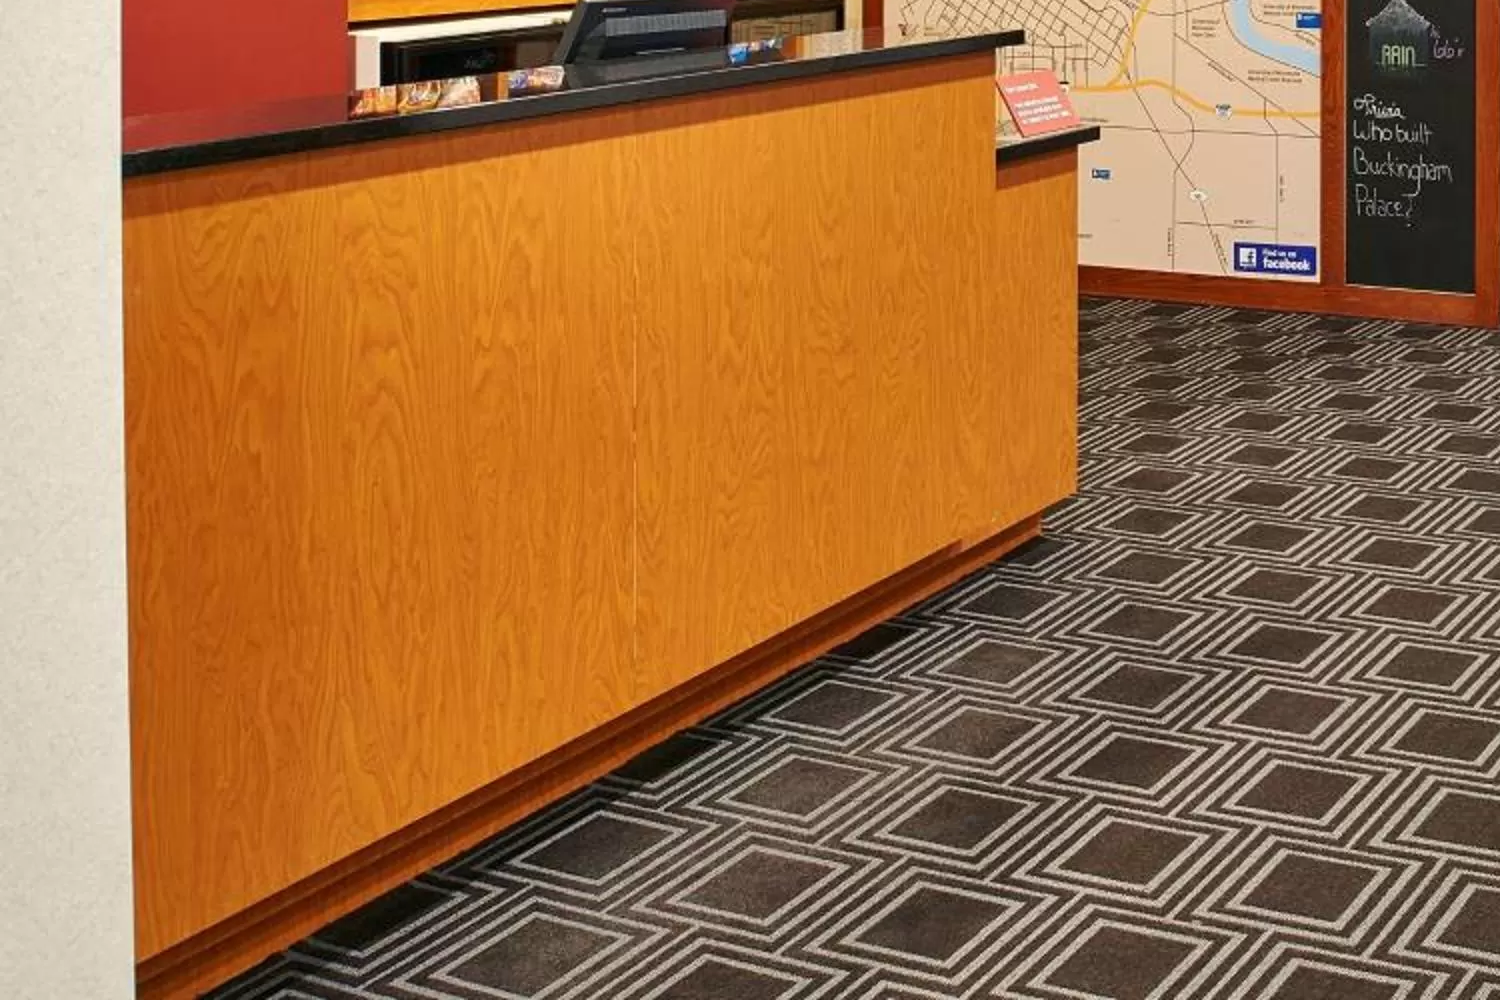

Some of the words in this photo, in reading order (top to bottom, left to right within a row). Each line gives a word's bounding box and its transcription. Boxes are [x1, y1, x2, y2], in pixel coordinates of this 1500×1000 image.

[1353, 120, 1393, 143] Who
[1395, 122, 1434, 146] built
[1353, 145, 1453, 197] Buckingham
[1355, 183, 1414, 228] Palace?
[1262, 257, 1311, 271] facebook
